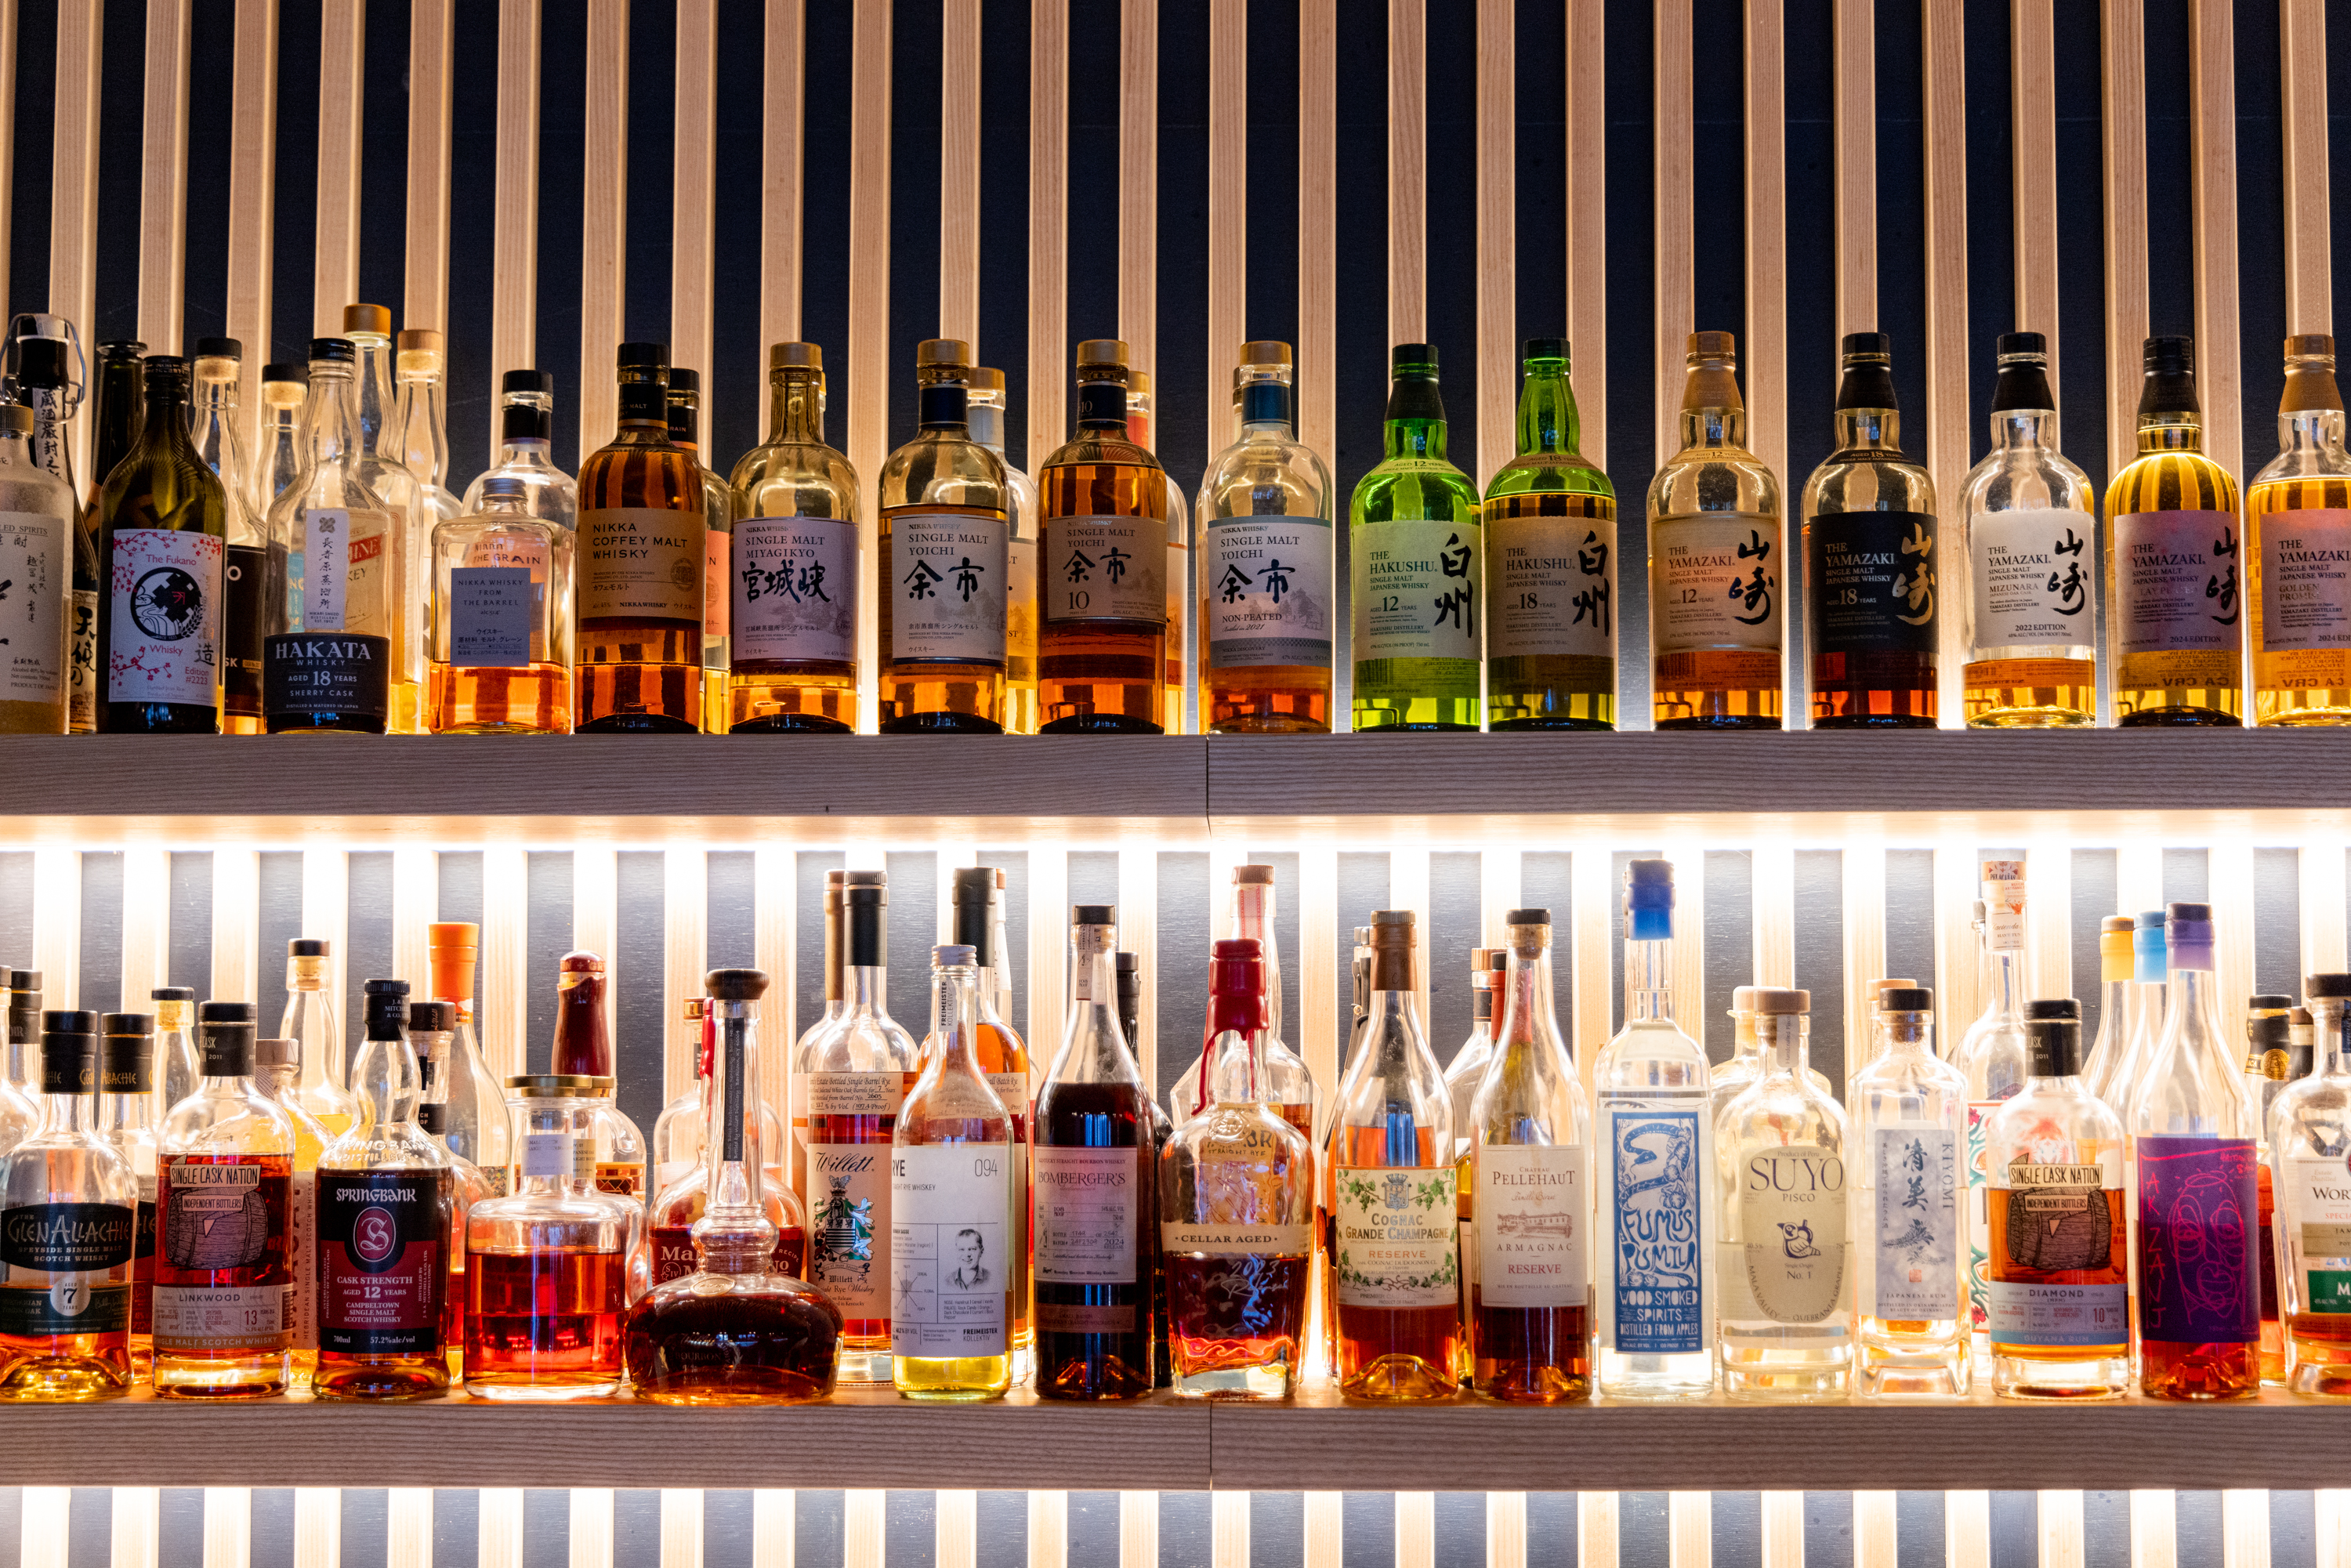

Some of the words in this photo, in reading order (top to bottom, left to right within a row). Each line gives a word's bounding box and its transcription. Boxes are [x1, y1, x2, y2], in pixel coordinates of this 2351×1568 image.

[19, 526, 48, 534] SPIRITS
[593, 523, 637, 534] NIKKA
[593, 536, 647, 547] COFFEY
[654, 536, 688, 548] MALT
[746, 535, 788, 545] SINGLE
[792, 536, 825, 545] MALT
[909, 534, 955, 542] SINGLE
[958, 534, 989, 544] MALT
[1221, 537, 1263, 548] SINGLE
[1266, 536, 1300, 545] MALT
[593, 549, 649, 560] WHISKY
[746, 549, 814, 559] MIYAGIKYO
[909, 547, 955, 556] YOICHI
[1506, 548, 1527, 556] THE
[1668, 546, 1688, 556] THE
[1825, 543, 1847, 553] THE
[1987, 546, 2008, 555] THE
[147, 555, 163, 563] The
[166, 556, 197, 566] Fukano
[1222, 550, 1263, 560] YOICHI
[1370, 551, 1389, 561] THE
[1825, 553, 1895, 567] YAMAZAKI
[1063, 547, 1132, 585] 余市
[1370, 561, 1434, 574] HAKUSHU
[1506, 558, 1572, 571] HAKUSHU
[1729, 529, 1774, 625] 山崎
[1892, 523, 1936, 625] 山崎
[2047, 527, 2088, 616] 山崎
[742, 559, 831, 603] 宮城峡
[904, 556, 984, 602] 余市
[1217, 559, 1296, 604] 余市
[1434, 532, 1473, 638] 白州
[1572, 530, 1610, 637] 白州
[1370, 583, 1400, 592] JAPANESE
[1990, 583, 2038, 592] MIZUNARA
[2279, 584, 2320, 592] GOLDEN
[1068, 591, 1089, 610] 10
[1382, 596, 1399, 612] 12
[1520, 592, 1538, 610] 18
[1223, 614, 1282, 623] NON-PEATED
[150, 645, 183, 657] Whisky
[276, 642, 371, 660] HAKATA
[185, 667, 208, 676] Edition
[186, 675, 208, 685] #2223
[313, 671, 331, 686] 18
[816, 1151, 874, 1173] Willett
[892, 1159, 906, 1177] RYE
[974, 1159, 998, 1177] 094
[172, 1168, 197, 1185] SINGLE
[200, 1167, 223, 1184] CASK
[226, 1168, 258, 1185] NATION
[1038, 1171, 1125, 1187] BOMBERGER'S
[1493, 1170, 1575, 1186] PELLEHAUT
[1750, 1157, 1843, 1191] SUYO
[1902, 1138, 1929, 1211] 清美
[1942, 1143, 1954, 1209] KIYOMI
[336, 1188, 417, 1202] SPRINGBANK
[1782, 1193, 1815, 1202] PISCO
[183, 1199, 216, 1208] INDEPENDENT
[216, 1199, 242, 1208] BOTTLERS
[2027, 1198, 2061, 1208] INDEPENDENT
[2061, 1199, 2086, 1209] BOTTLERS
[1371, 1213, 1422, 1226] COGNAC
[1621, 1208, 1694, 1244] FUMUS
[1181, 1234, 1231, 1243] CELLAR
[1235, 1234, 1272, 1244] AGED
[1346, 1226, 1384, 1240] GRANDE
[1387, 1226, 1448, 1240] CHAMPAGNE
[1497, 1243, 1573, 1251] ARMAGNAC
[1621, 1241, 1697, 1275] PUMILA
[1508, 1264, 1561, 1274] RESERVE
[337, 1276, 359, 1284] CASK
[63, 1288, 78, 1304] 7
[364, 1286, 381, 1298] 12
[1620, 1290, 1653, 1305] WOOD
[1655, 1290, 1698, 1305] SMOKED
[1749, 1266, 1759, 1291] MALA
[1755, 1292, 1780, 1319] VALLEY
[1792, 1298, 1836, 1321] QUEBRANTA
[1833, 1266, 1842, 1298] GRAPES
[2029, 1289, 2084, 1298] DIAMOND
[245, 1310, 258, 1325] 13
[1637, 1308, 1683, 1322] SPIRITS
[2093, 1308, 2105, 1324] 10
[1620, 1324, 1652, 1335] DISTILLED
[1655, 1324, 1675, 1335] FROM
[1676, 1323, 1698, 1335] APPLES
